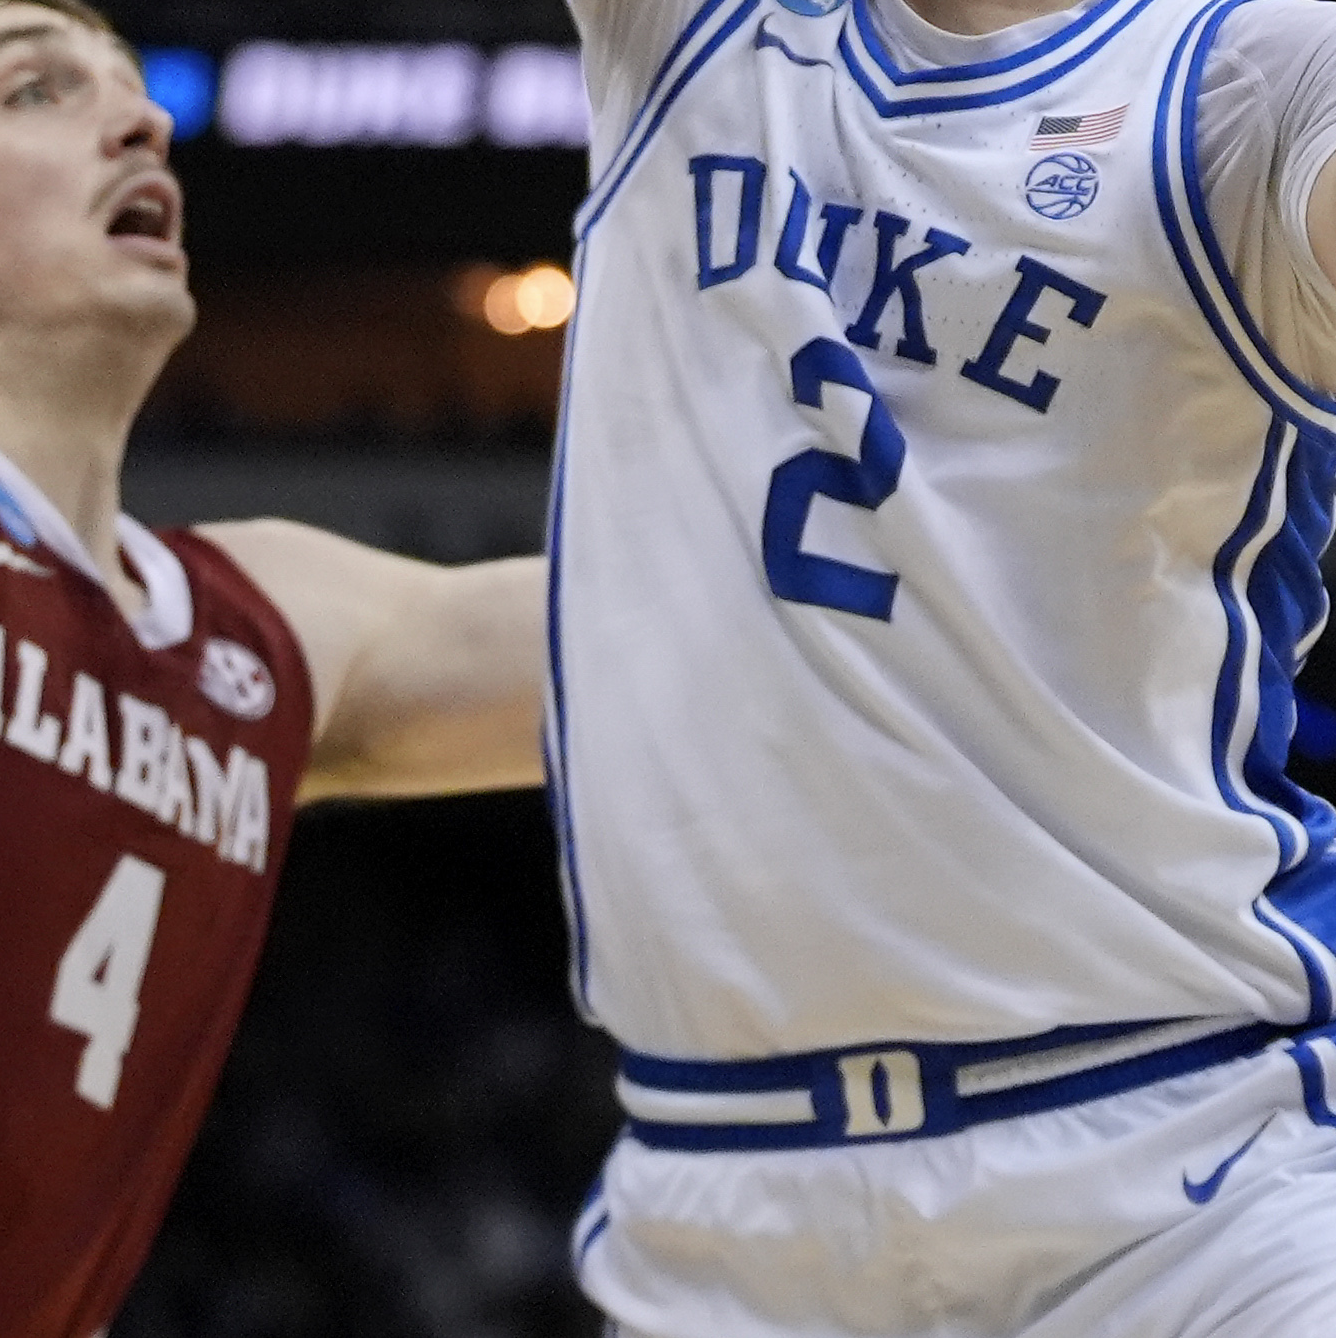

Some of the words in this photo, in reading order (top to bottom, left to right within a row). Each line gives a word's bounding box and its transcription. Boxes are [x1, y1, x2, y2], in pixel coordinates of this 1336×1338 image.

[689, 153, 1109, 414] DUKE
[764, 336, 906, 623] 2
[49, 853, 166, 1112] 4
[837, 1049, 926, 1137] D
